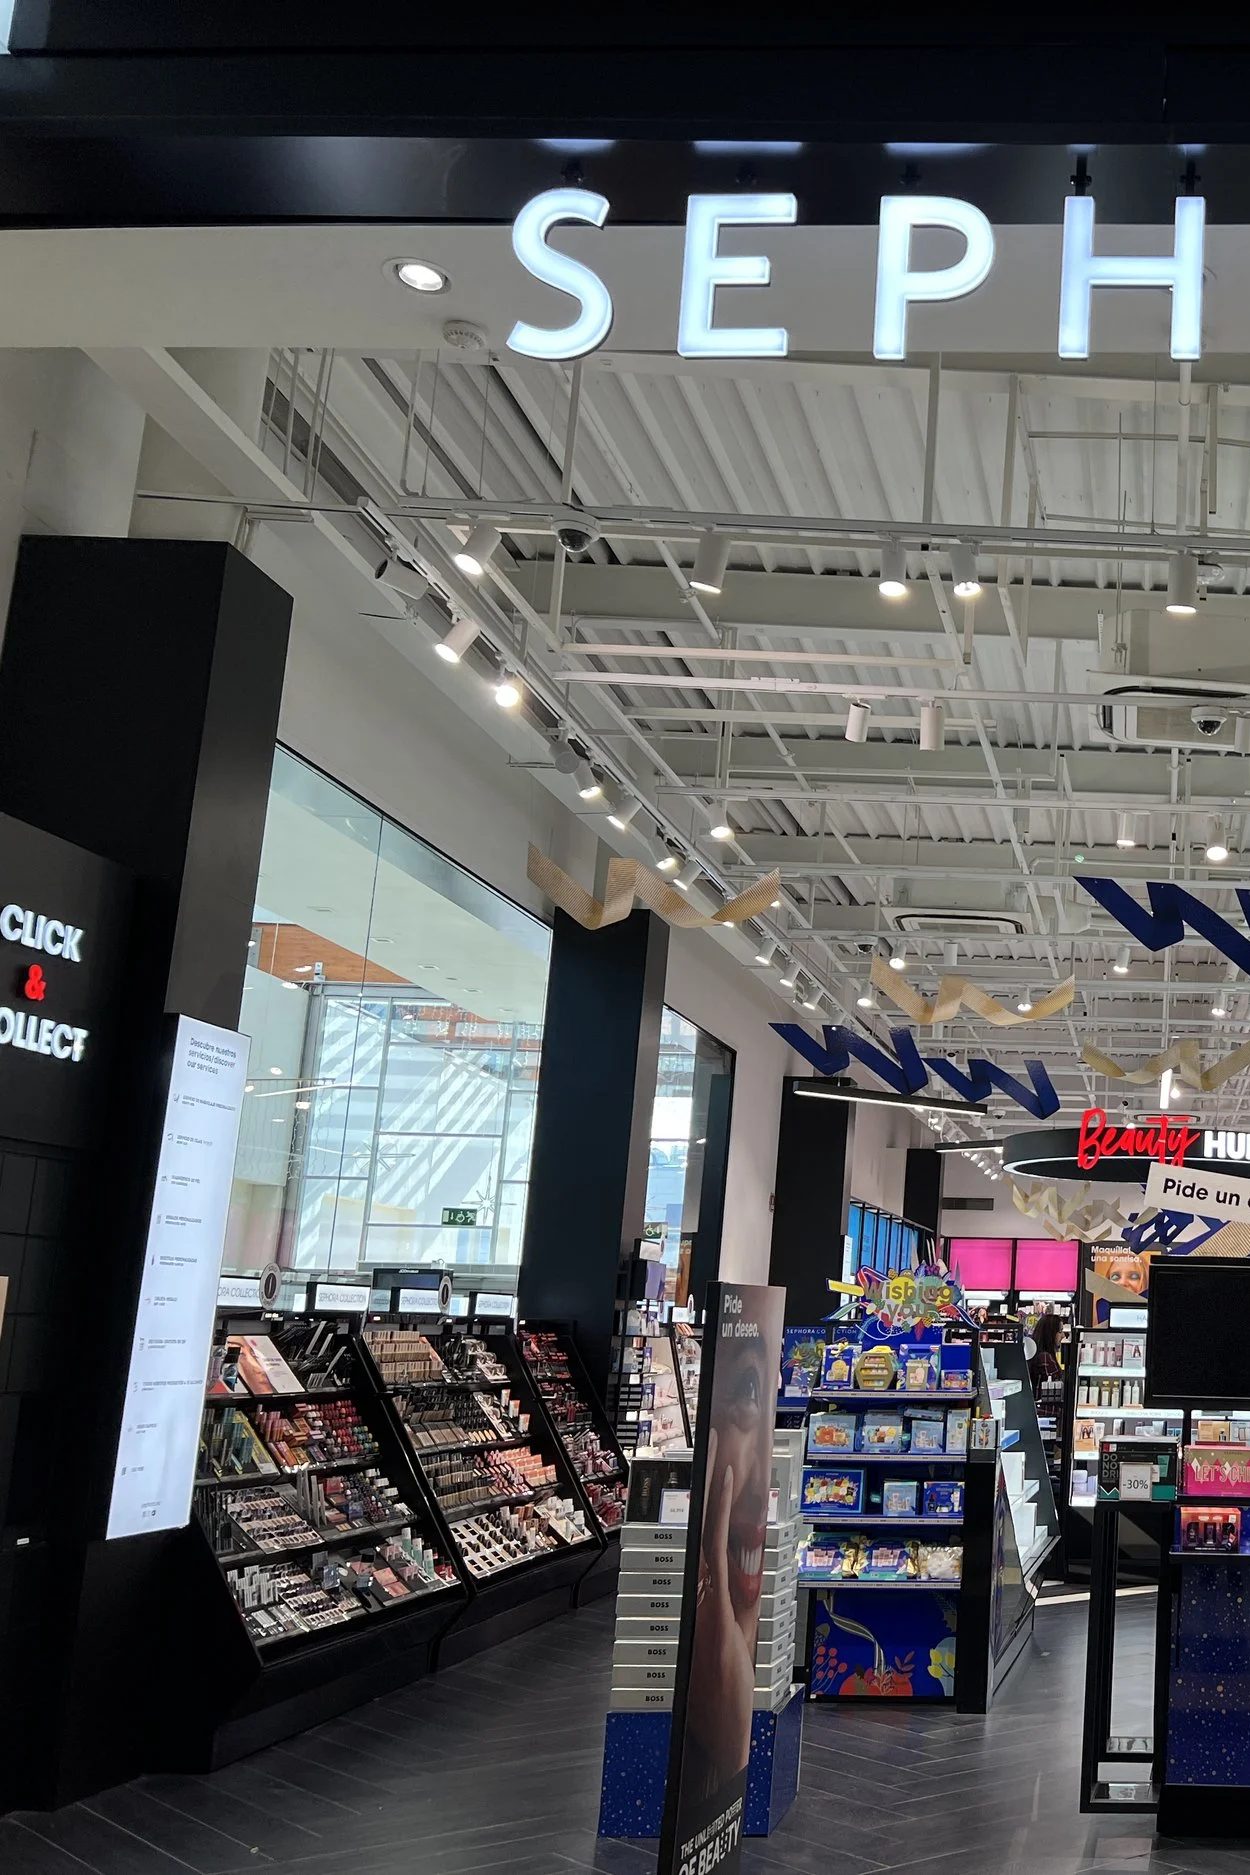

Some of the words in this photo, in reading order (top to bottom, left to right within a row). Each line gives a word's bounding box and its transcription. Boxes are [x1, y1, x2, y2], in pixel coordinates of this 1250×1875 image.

[0, 904, 84, 962] CLICK
[24, 964, 47, 1001] &
[0, 1006, 89, 1062] OLLECT
[190, 1037, 215, 1053] Descubre
[215, 1046, 237, 1059] nuestros
[196, 1062, 218, 1075] services
[1078, 1108, 1200, 1169] Beauty
[1163, 1177, 1209, 1200] Pide
[1216, 1190, 1240, 1206] un
[1109, 1255, 1142, 1263] sonrisa.
[723, 1294, 743, 1314] Pide
[721, 1322, 733, 1338] un
[734, 1319, 760, 1338] deseo.
[1103, 1453, 1118, 1462] DO
[1194, 1464, 1228, 1483] LET'S
[1122, 1479, 1149, 1490] -30%
[681, 1837, 695, 1860] THE
